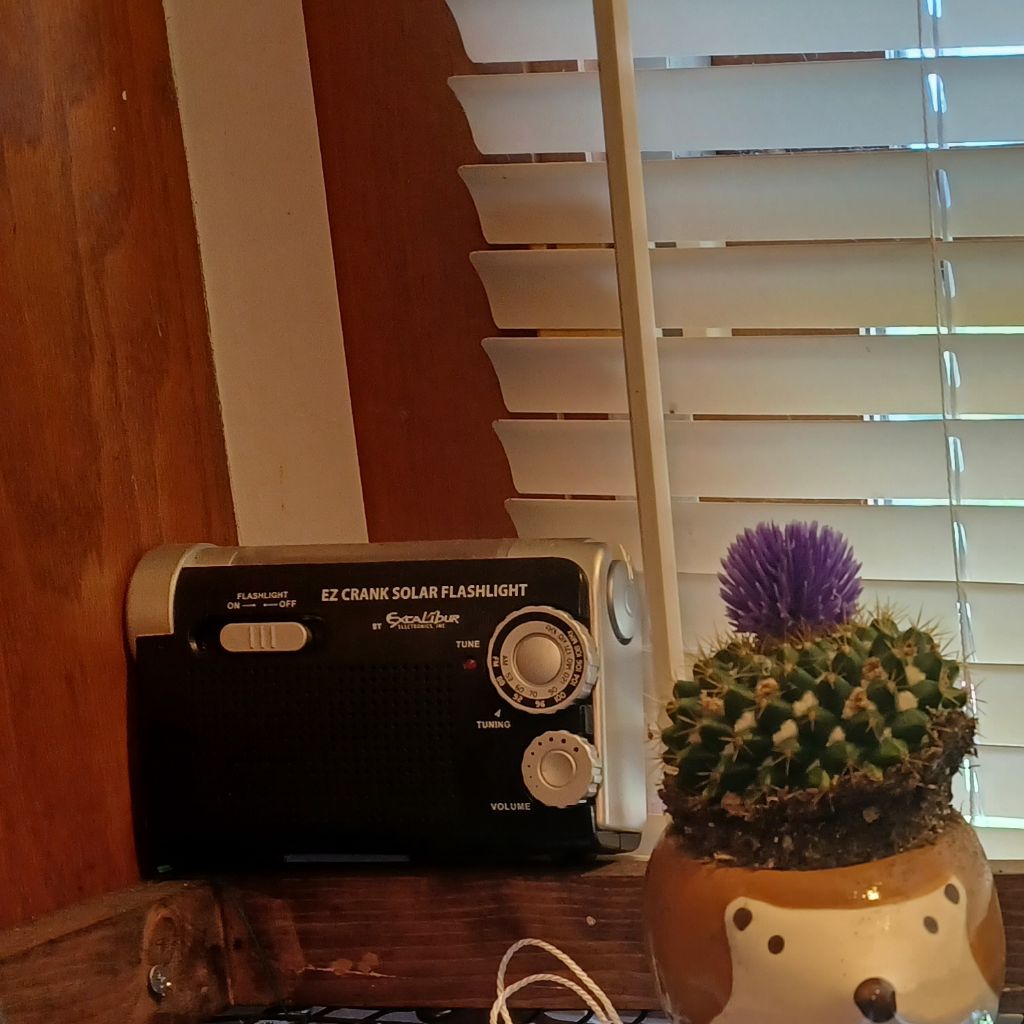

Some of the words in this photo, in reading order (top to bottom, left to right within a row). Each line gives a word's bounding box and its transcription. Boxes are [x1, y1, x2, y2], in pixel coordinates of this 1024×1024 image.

[236, 591, 289, 600] FLASHLIGHT
[321, 588, 339, 601] EZ
[341, 587, 389, 601] CRANK
[392, 586, 438, 600] SOLAR
[441, 584, 528, 598] FLASHLIGHT
[227, 601, 241, 610] ON
[279, 600, 297, 608] OFF
[456, 640, 481, 648] TUNE
[502, 655, 509, 666] AM
[492, 655, 500, 668] FM
[512, 693, 523, 703] 92
[535, 700, 546, 708] 96
[553, 691, 567, 703] 100
[476, 720, 512, 729] TUNING
[490, 802, 532, 811] VOLUME
